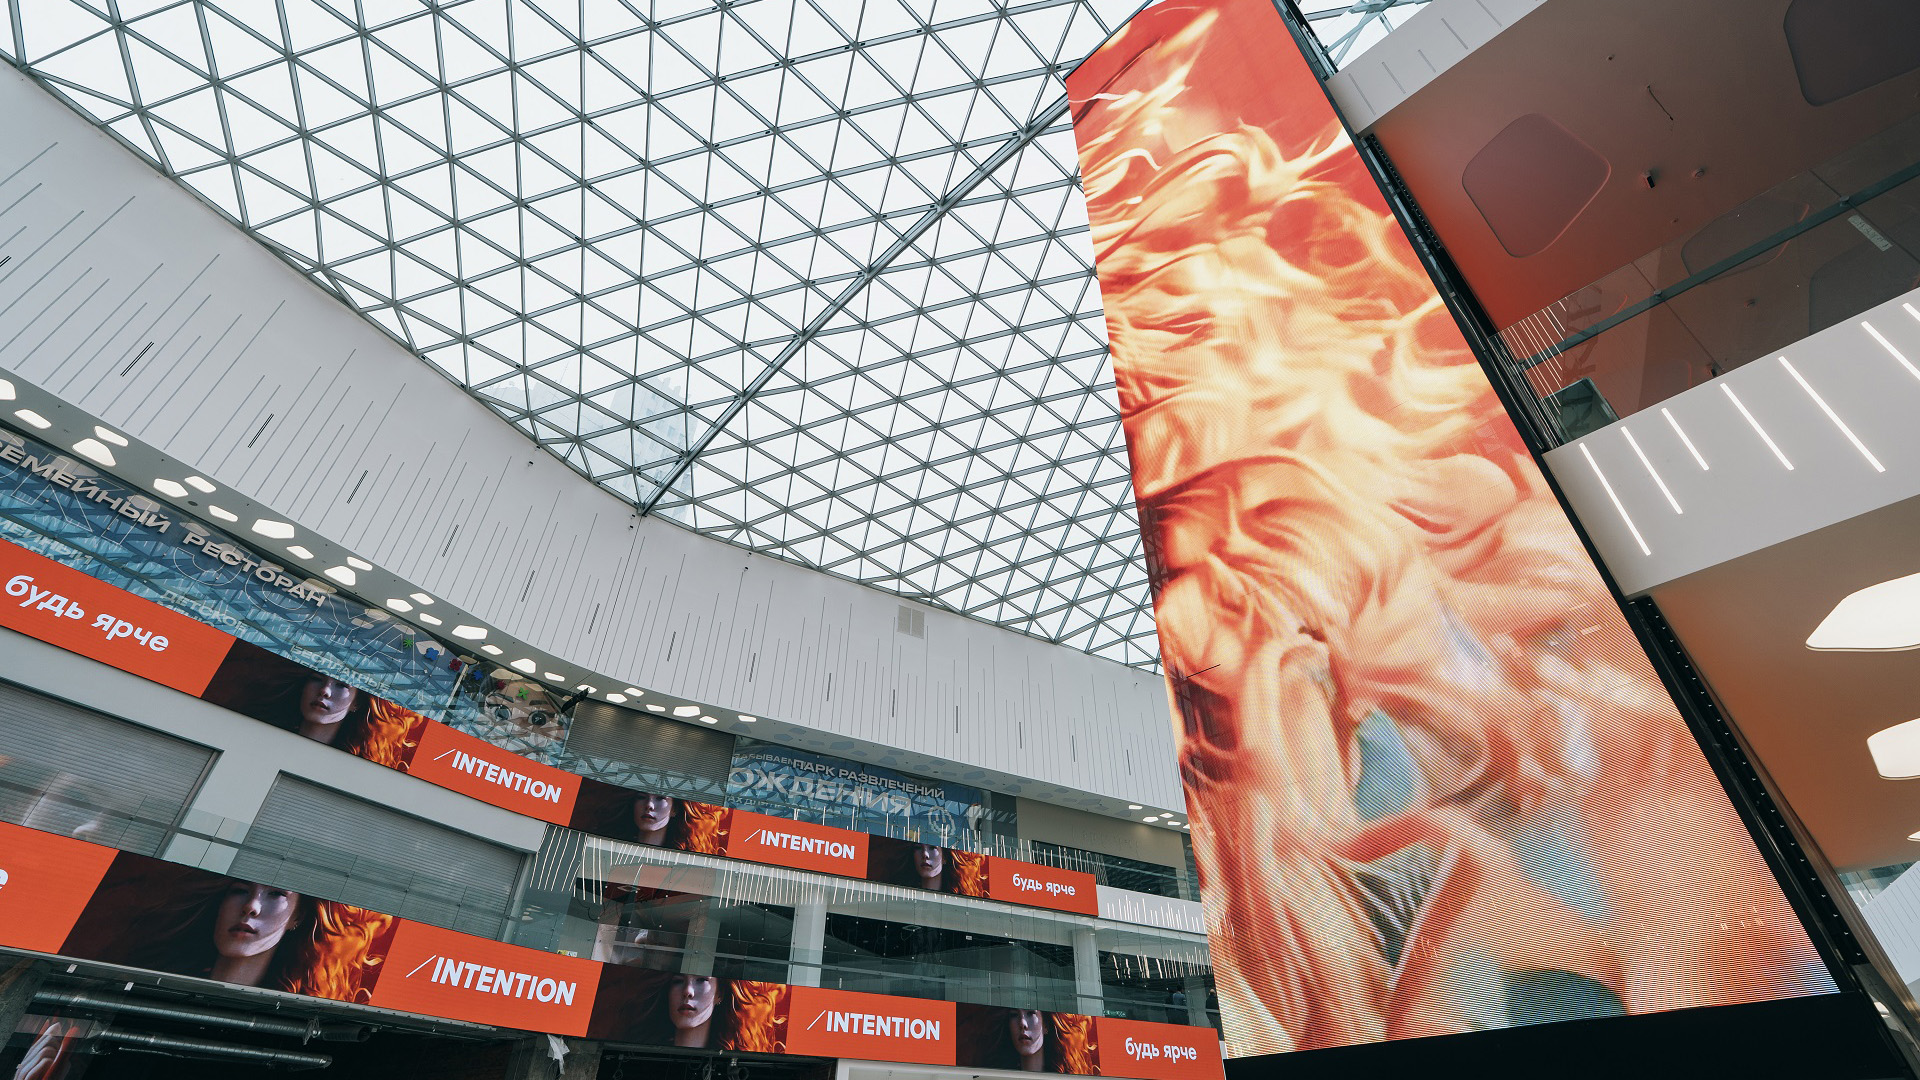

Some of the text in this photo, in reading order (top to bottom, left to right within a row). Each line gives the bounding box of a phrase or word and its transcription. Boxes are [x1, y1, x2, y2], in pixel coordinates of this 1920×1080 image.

[0, 439, 172, 534] ЕМЕЙНЫЙ
[182, 530, 326, 608] РЕСТОРАН
[4, 574, 85, 620] будь
[91, 613, 169, 653] ярче
[160, 589, 249, 638] ДЕТСКОЕ
[792, 759, 945, 799] ПАРК РАЗВЛЕЧЕНИЙ
[1012, 873, 1076, 897] будь ярче
[1125, 1037, 1197, 1063] будь ярче
